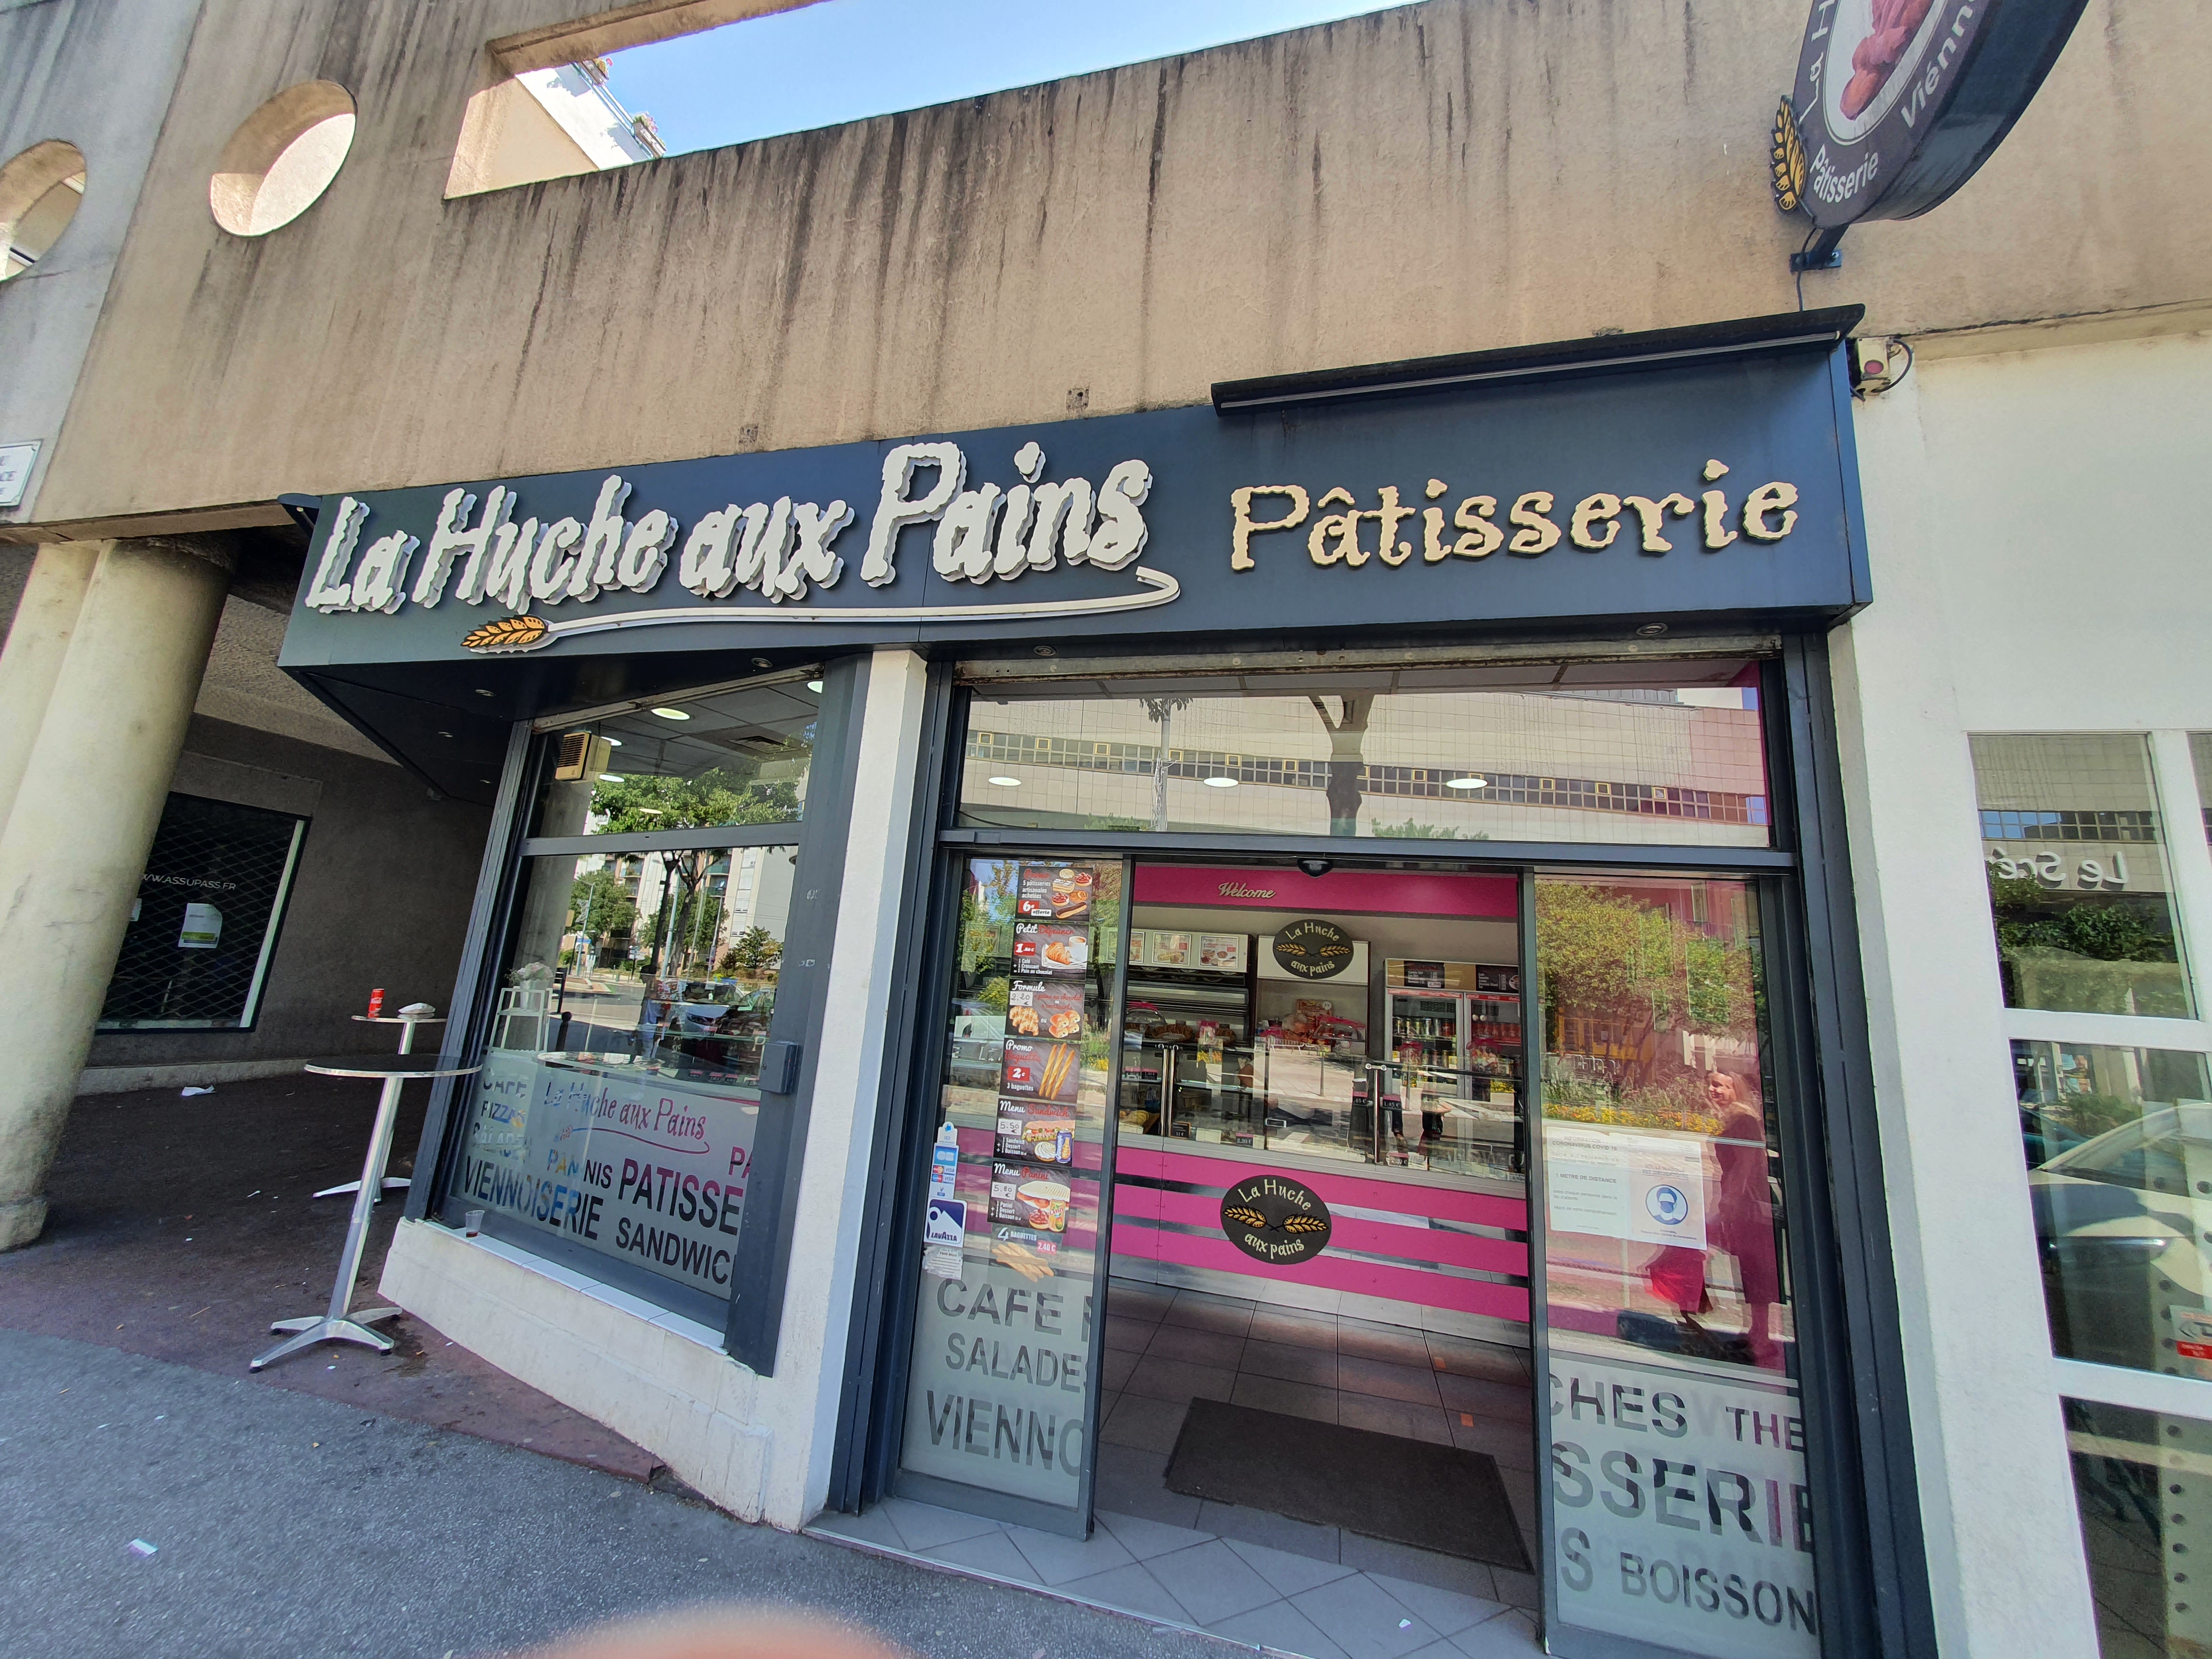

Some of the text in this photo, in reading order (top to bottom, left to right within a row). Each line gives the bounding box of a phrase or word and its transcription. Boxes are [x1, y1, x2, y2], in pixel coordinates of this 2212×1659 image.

[1901, 0, 1976, 128] Viénn
[1799, 52, 1824, 124] La
[1810, 144, 1879, 203] Pâtisserie
[306, 442, 1152, 614] La Huche aux Pains
[1230, 459, 1799, 571] Pâtisserie
[1023, 868, 1050, 879] Promo
[1218, 881, 1276, 899] Welcome
[1016, 923, 1075, 937] Petit Déjeuner
[1286, 922, 1340, 941] La Huche
[1291, 960, 1335, 976] aux pains
[1012, 980, 1046, 992] Formule
[1006, 1039, 1034, 1052] Promo
[1011, 1083, 1034, 1092] baguettes
[544, 1081, 707, 1140] La Huche aux Pains
[1000, 1100, 1069, 1118] Menu Sandwich
[1552, 1141, 1591, 1149] CORONAVIRUS
[994, 1163, 1049, 1180] Menu Panini
[464, 1155, 604, 1241] VIENNOISERIE
[618, 1157, 744, 1237] PATISSE
[1238, 1178, 1311, 1211] La Huche
[930, 1231, 957, 1242] LAVAZZA
[998, 1227, 1037, 1241] 4 BAGUETTES
[1244, 1233, 1305, 1260] aux pains
[616, 1217, 737, 1287] SANDWIC
[937, 1278, 1064, 1336] CAFE
[945, 1332, 1087, 1394] SALADE
[1725, 1406, 1804, 1453] THE
[1620, 1551, 1817, 1635] BOISSON
